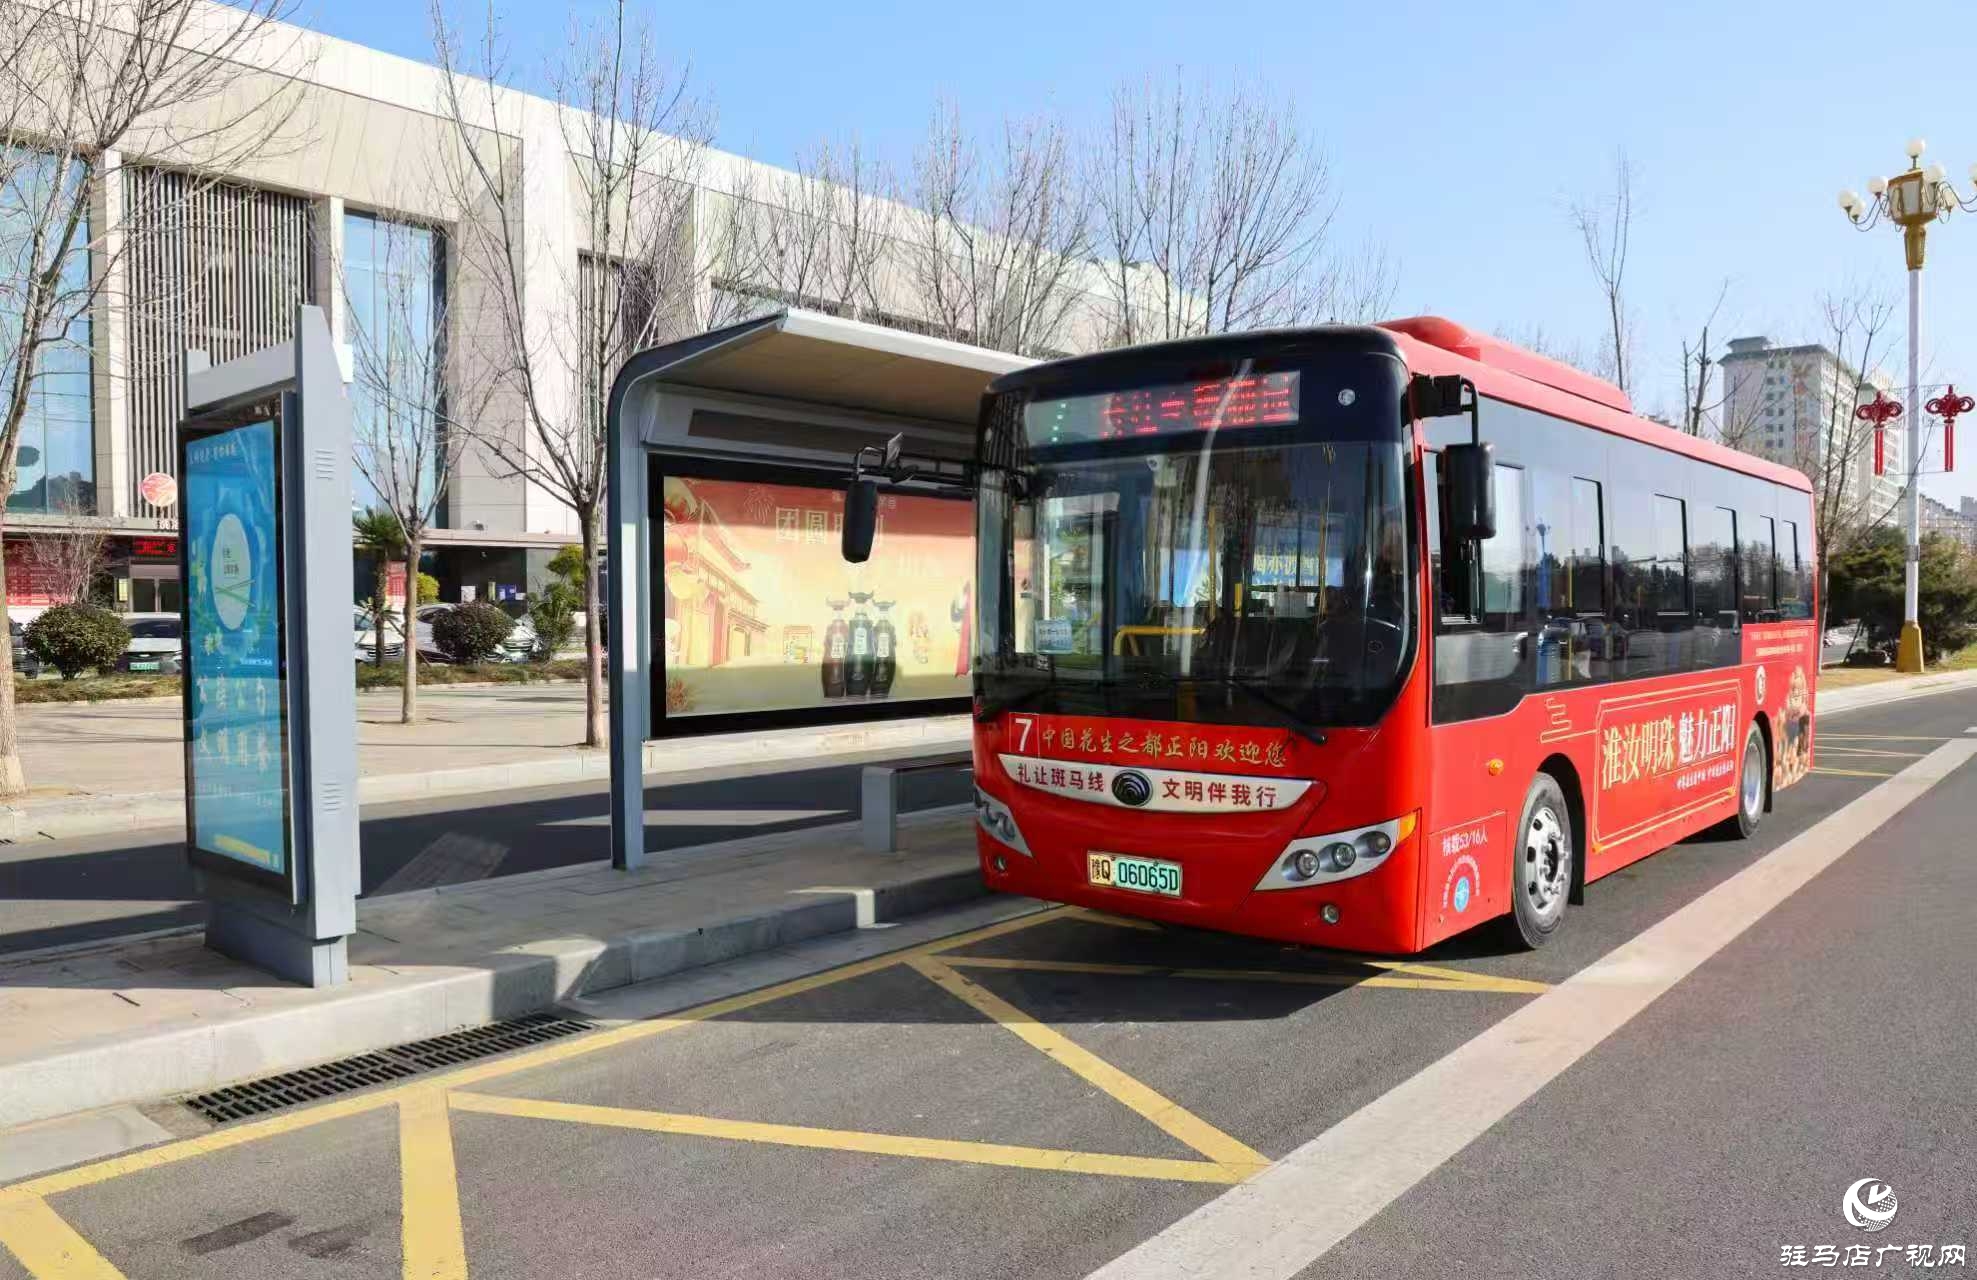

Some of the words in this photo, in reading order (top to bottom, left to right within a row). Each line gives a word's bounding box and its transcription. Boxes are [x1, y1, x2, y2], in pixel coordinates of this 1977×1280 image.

[1015, 718, 1032, 752] 7
[1042, 726, 1286, 767] 中国花生之都正阳欢迎您
[1602, 717, 1675, 789] 淮汝明珠
[1679, 704, 1736, 762] 魅力正阳
[1017, 763, 1104, 792] 礼让斑马线
[1162, 778, 1277, 808] 文明伴我行
